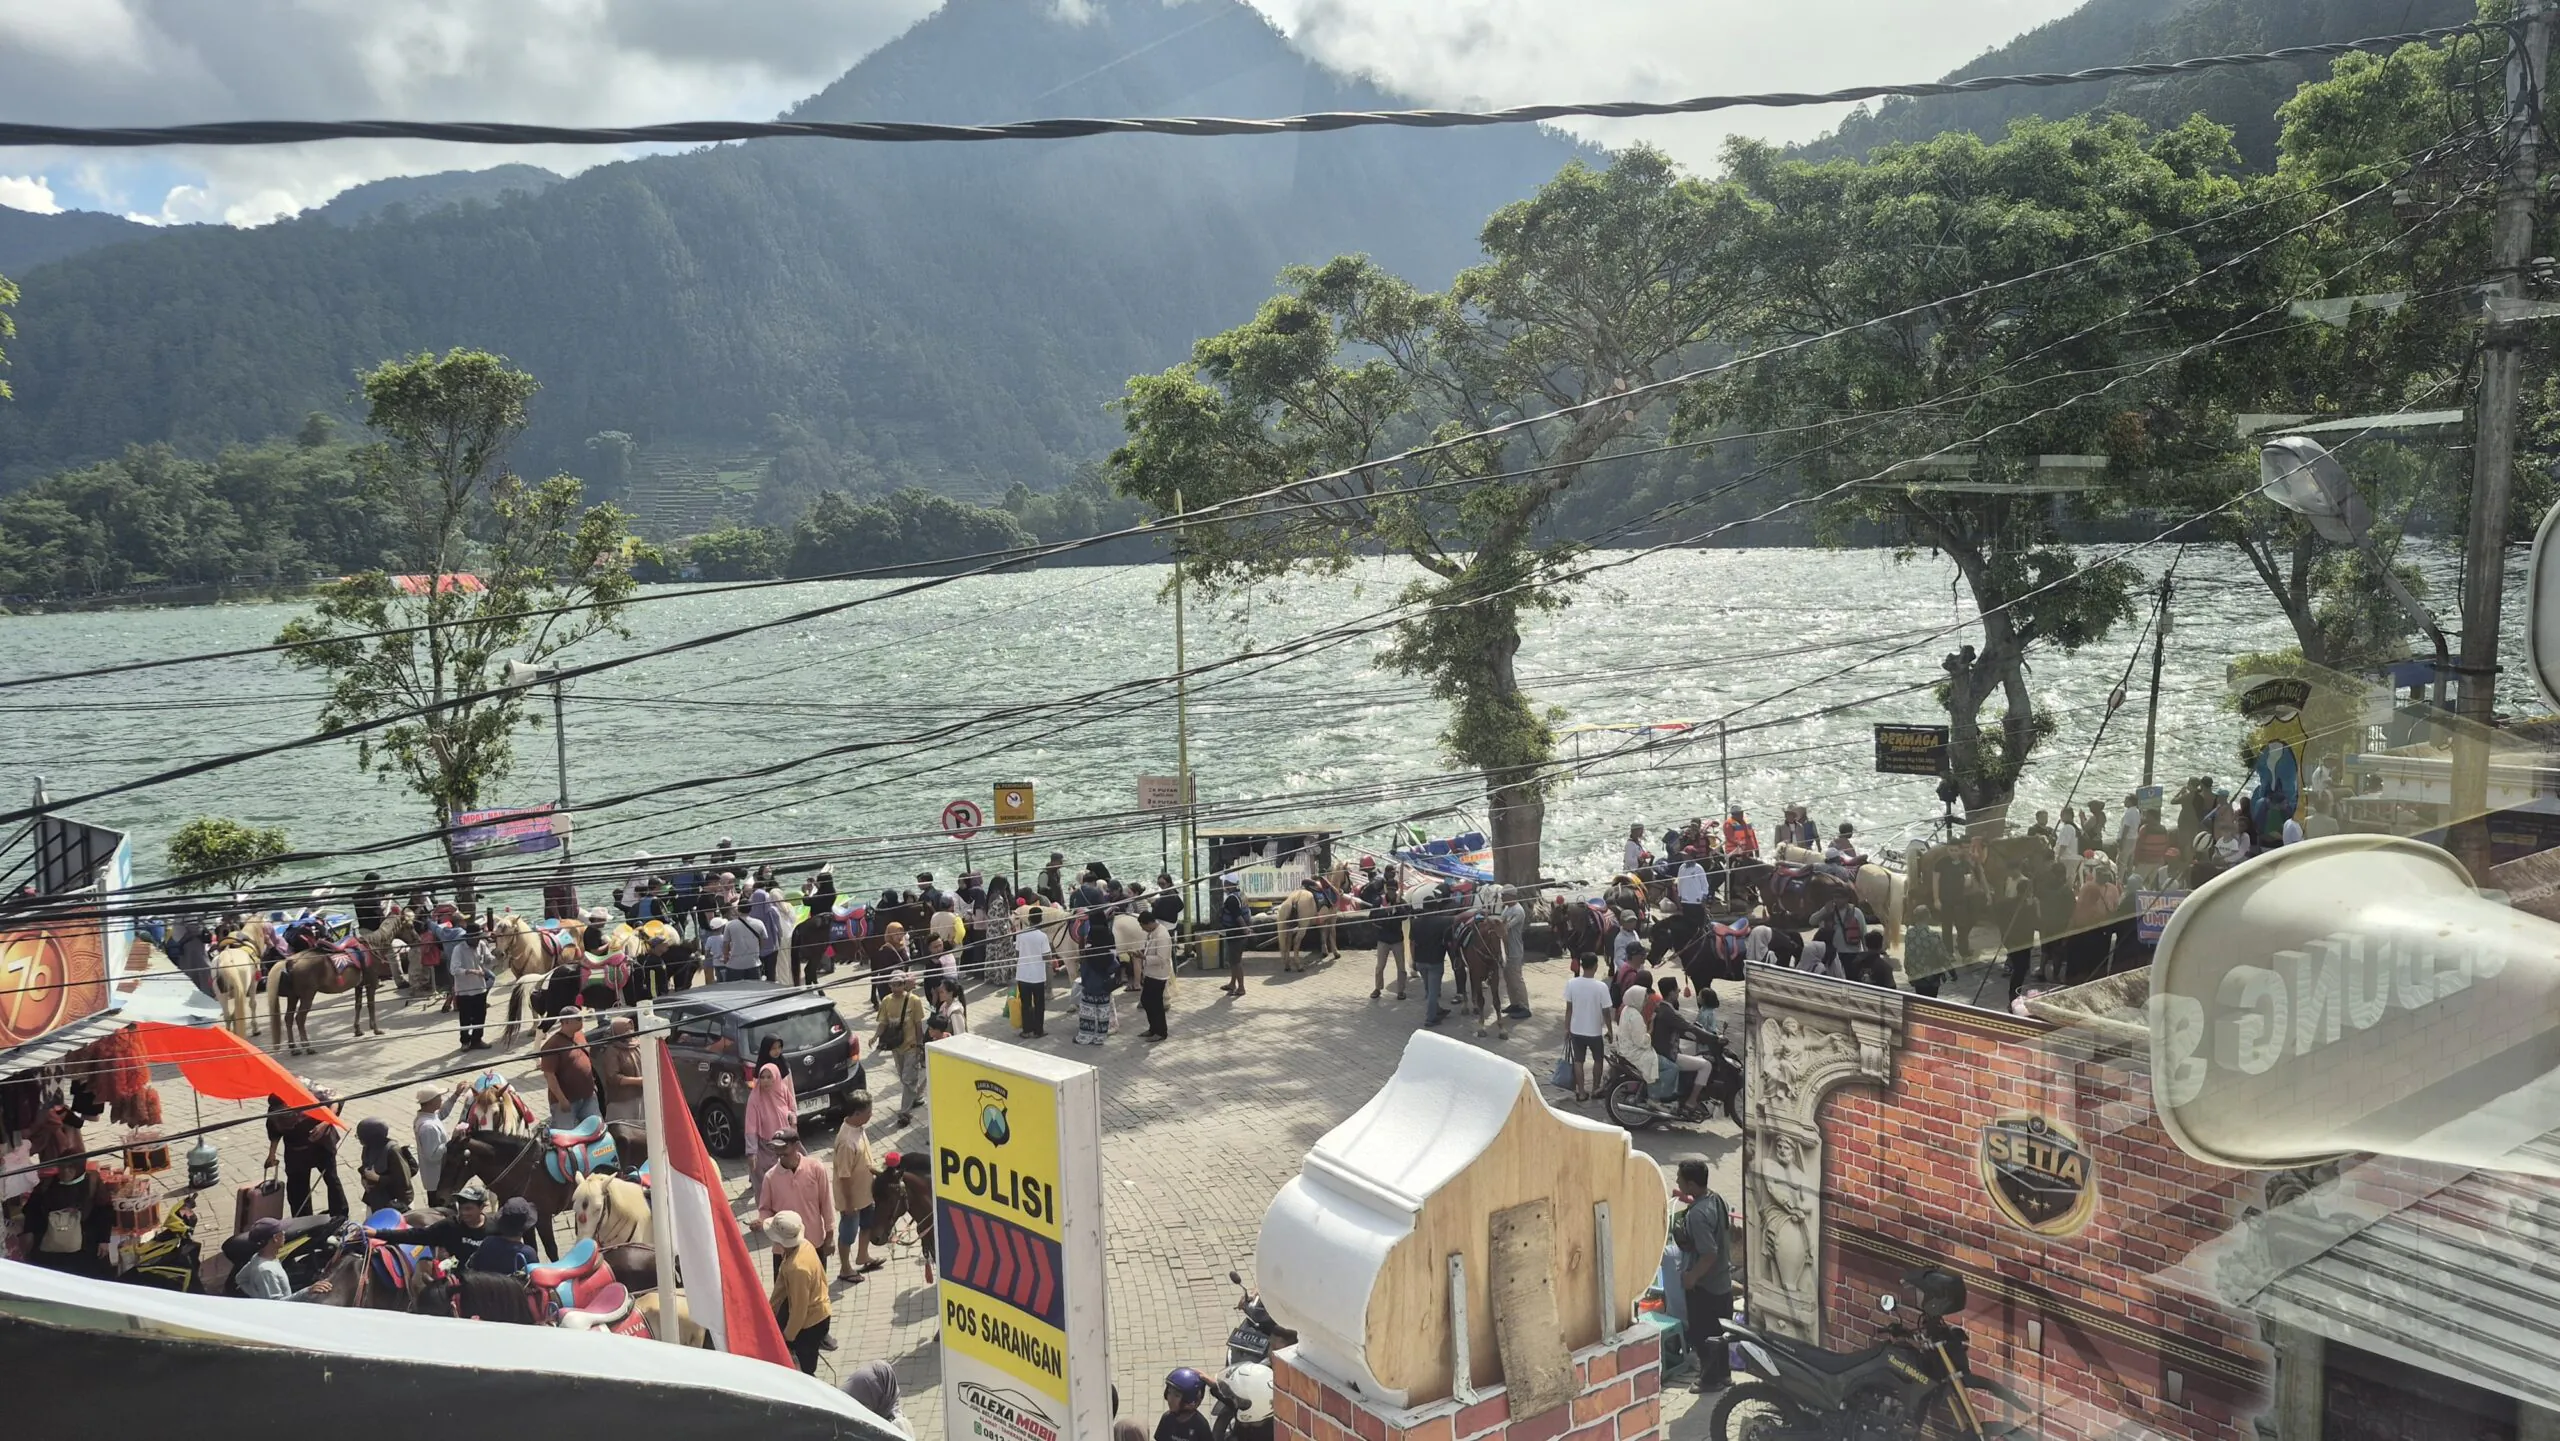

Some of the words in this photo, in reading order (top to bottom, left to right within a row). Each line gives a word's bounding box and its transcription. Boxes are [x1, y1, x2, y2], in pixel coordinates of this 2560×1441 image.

[1880, 732, 1939, 746] DERMAGA
[7, 929, 51, 1032] 76
[940, 1146, 1054, 1225] POLISI
[1988, 1132, 2084, 1189] SETIA
[947, 1299, 977, 1335] POS
[981, 1314, 1062, 1379] SARANGAN
[970, 1391, 1014, 1422] ALEXA
